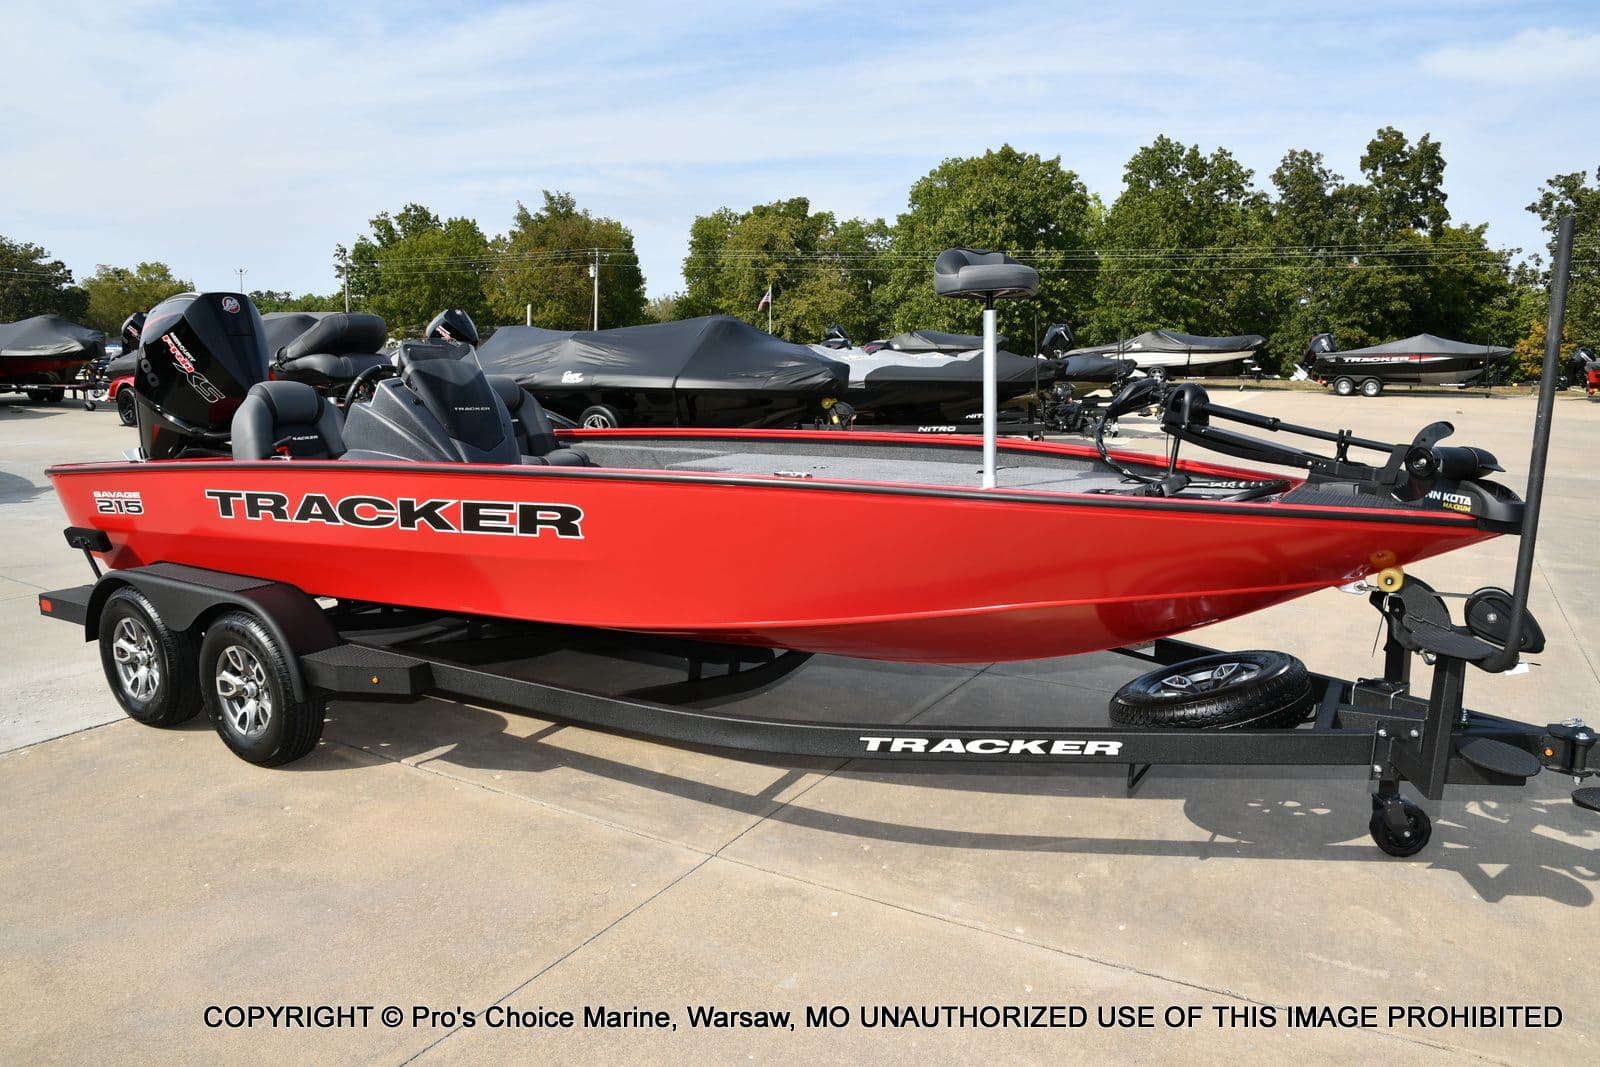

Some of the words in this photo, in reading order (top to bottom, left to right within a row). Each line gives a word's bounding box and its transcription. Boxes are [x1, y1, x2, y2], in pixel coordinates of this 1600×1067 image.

[169, 332, 196, 362] MERCURY
[172, 362, 226, 403] XS
[96, 499, 144, 515] 215
[1442, 492, 1472, 505] KOTA
[205, 489, 584, 539] TRACKER
[859, 736, 1123, 756] TRACKER
